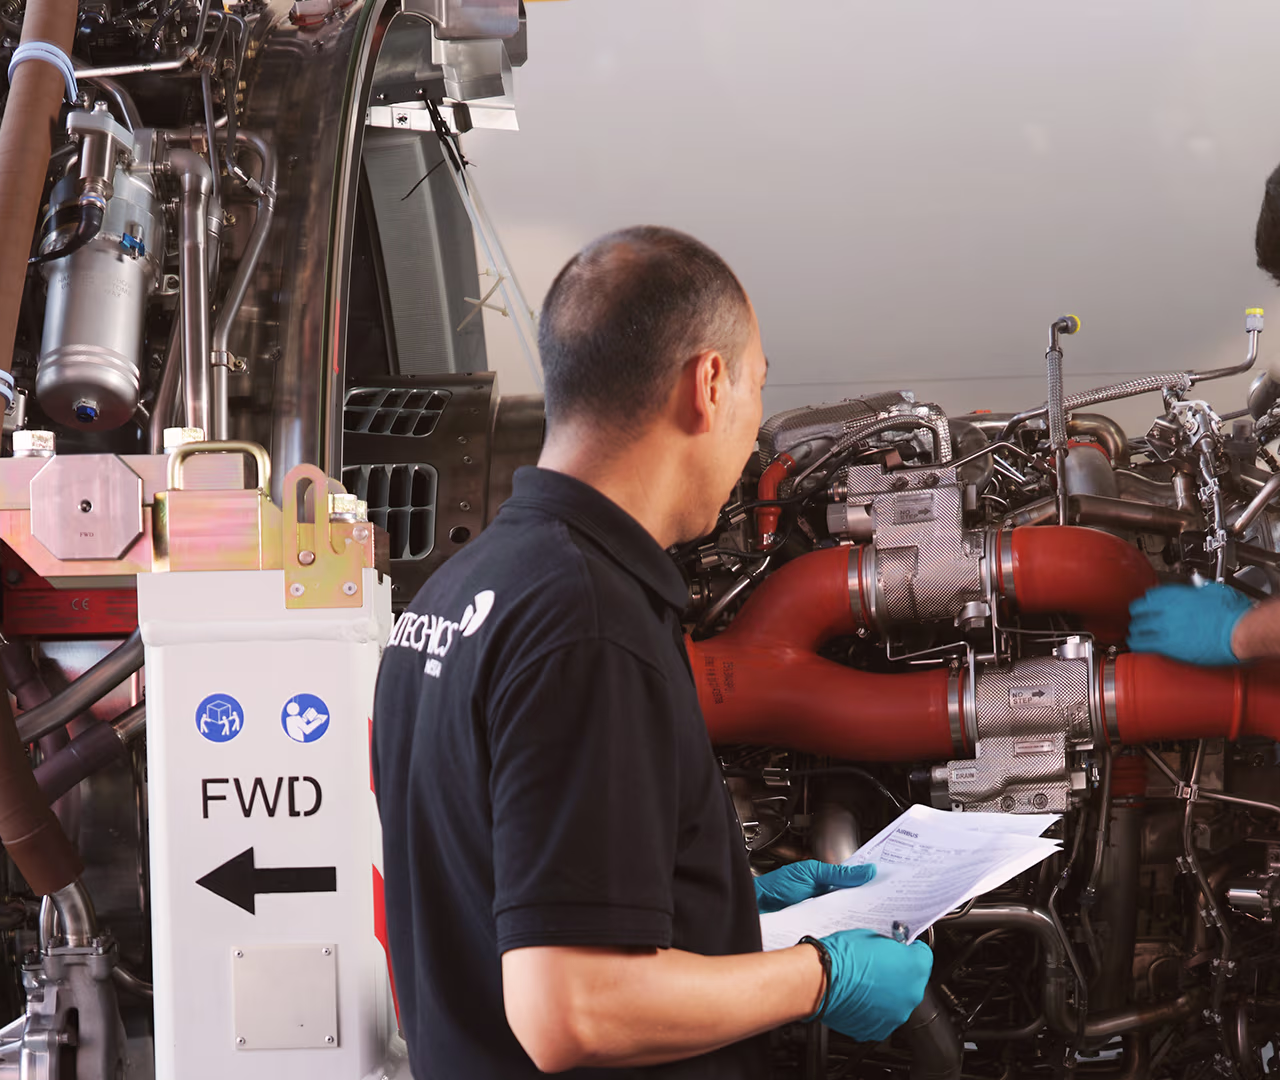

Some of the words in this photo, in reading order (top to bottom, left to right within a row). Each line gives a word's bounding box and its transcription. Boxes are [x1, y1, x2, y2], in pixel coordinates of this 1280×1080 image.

[1013, 697, 1033, 705] STEP
[202, 776, 322, 818] FWD
[896, 828, 919, 838] AIRBUS
